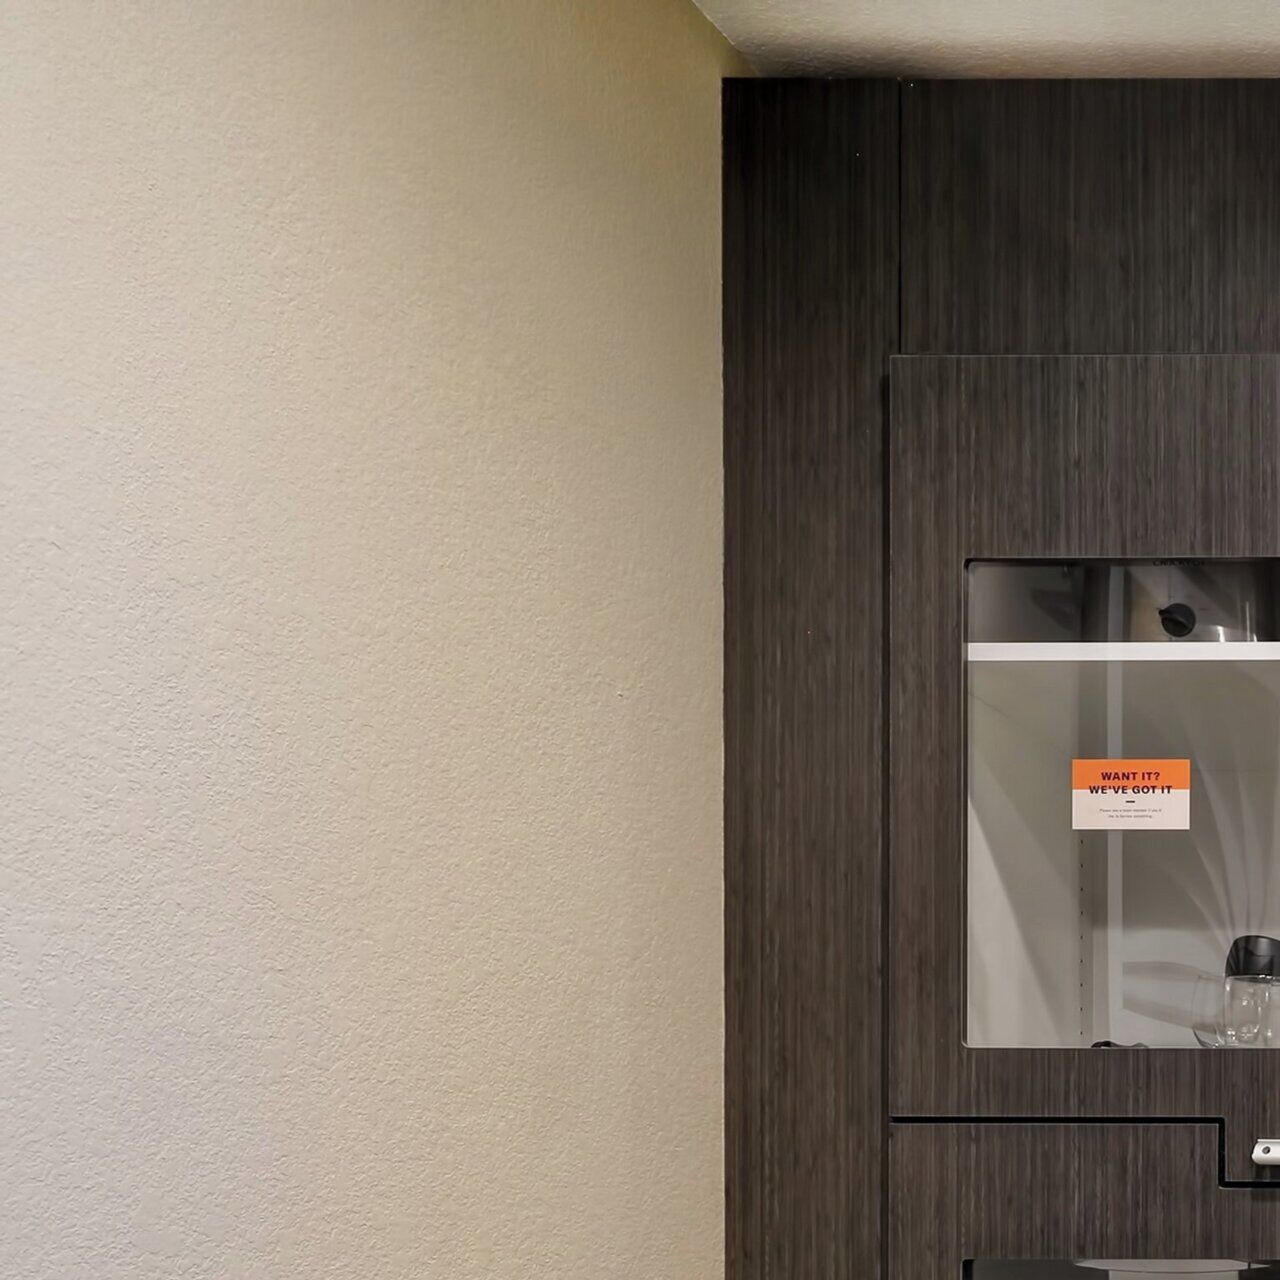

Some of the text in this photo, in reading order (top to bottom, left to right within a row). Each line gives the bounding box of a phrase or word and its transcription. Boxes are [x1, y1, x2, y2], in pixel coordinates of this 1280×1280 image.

[1101, 771, 1160, 781] WANT IT?
[1089, 785, 1173, 794] WE'VE GOT IT
